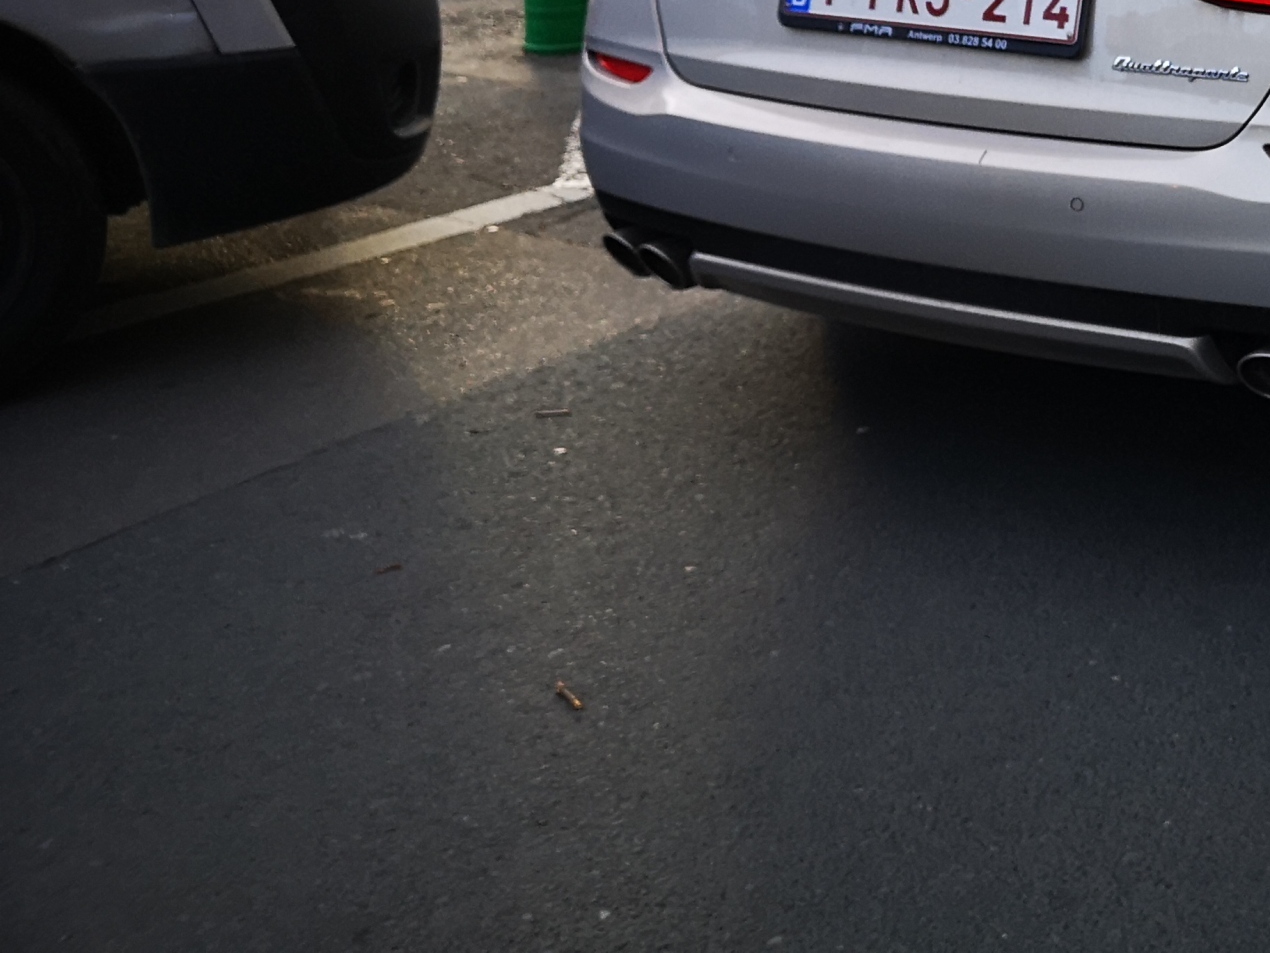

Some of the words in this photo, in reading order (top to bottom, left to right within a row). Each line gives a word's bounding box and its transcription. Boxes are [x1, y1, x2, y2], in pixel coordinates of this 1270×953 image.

[907, 30, 943, 43] Antwerp
[947, 33, 980, 46] 03.828
[981, 37, 993, 48] 54
[994, 38, 1008, 50] 00
[1112, 56, 1249, 82] Quattroporte
